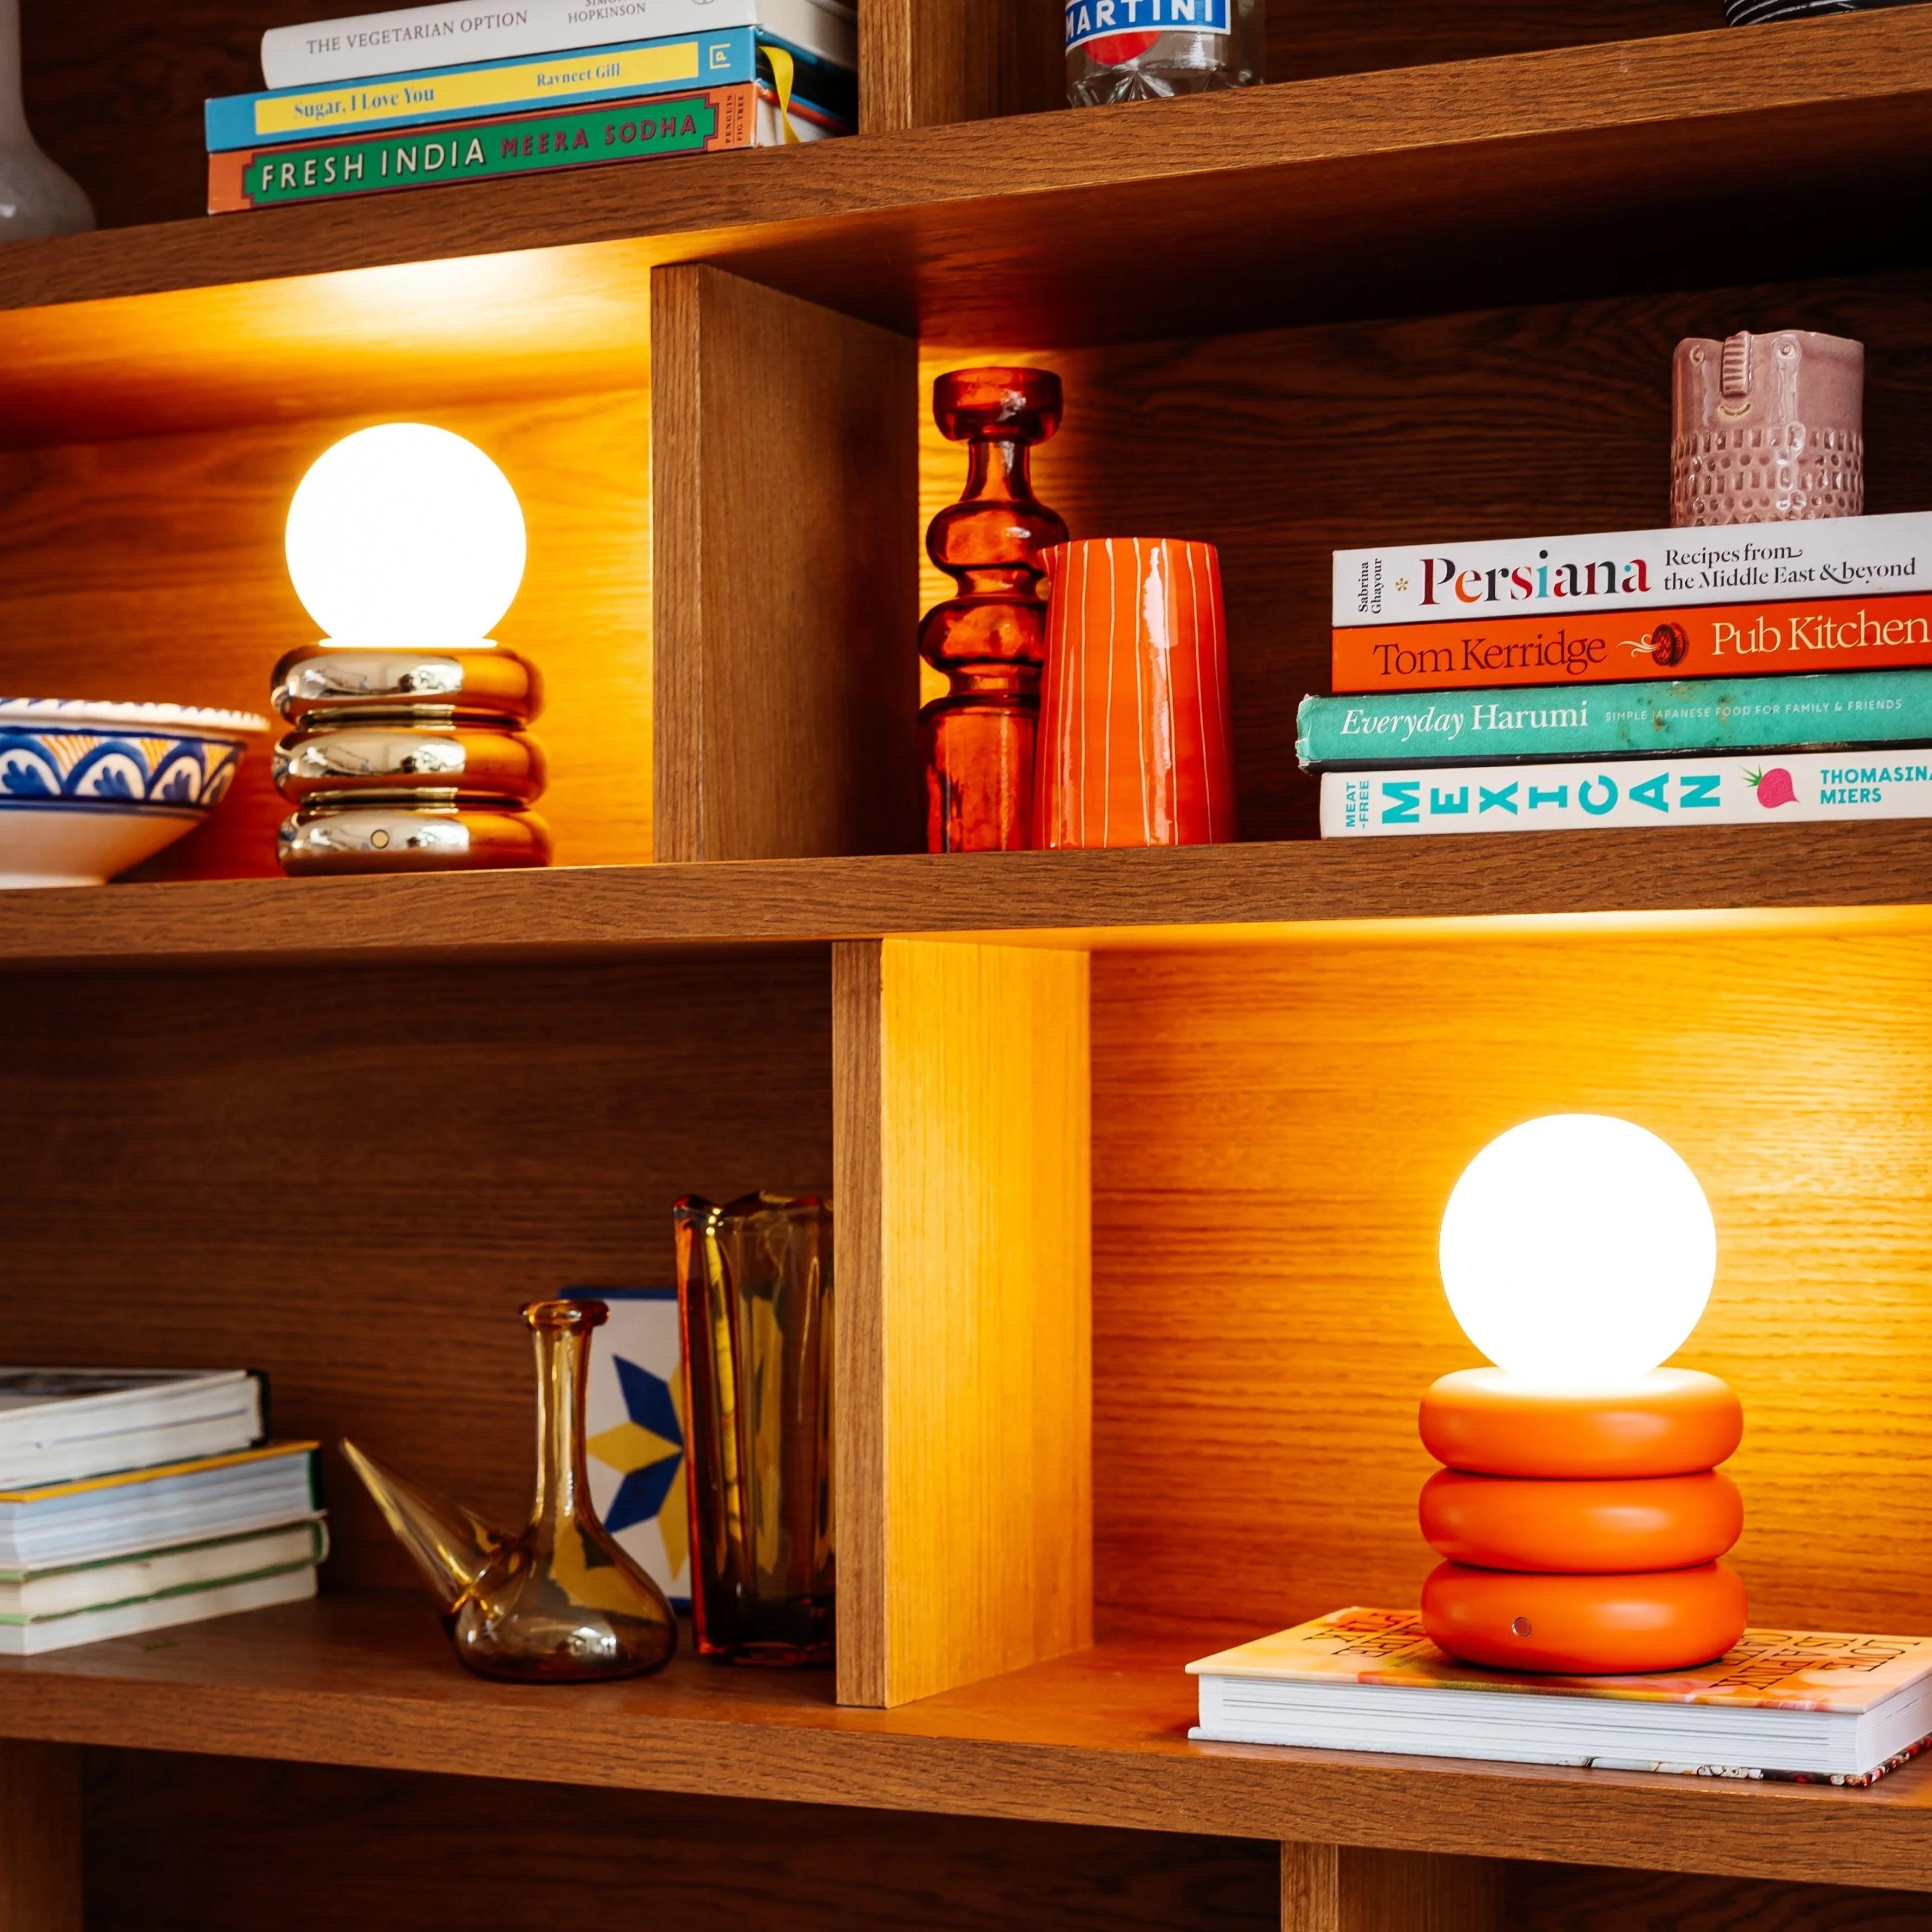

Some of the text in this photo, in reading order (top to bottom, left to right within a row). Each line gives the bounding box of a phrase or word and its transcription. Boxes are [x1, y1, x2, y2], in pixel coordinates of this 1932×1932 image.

[306, 10, 529, 54] THE VEGETARIAN OPTION
[568, 3, 646, 23] HOPKINSON
[1066, 0, 1213, 41] MARTINI
[537, 62, 620, 87] Ravneet Gill
[294, 87, 435, 121] Sugar, I Love You
[725, 95, 733, 144] PENGUIN
[501, 114, 696, 159] MEERA SODHA
[261, 137, 485, 193] FRESH INDIA
[1418, 550, 1652, 606] Persiana
[1664, 557, 1917, 591] the Middle East & beyond
[1665, 543, 1804, 569] Recipes from
[1358, 561, 1369, 612] Sabrina
[1370, 558, 1383, 614] Ghayour
[1373, 629, 1607, 676] Tom Kerridge
[1711, 609, 1931, 657] Pub Kitchen
[1340, 700, 1588, 742] Everyday Harumi
[1605, 698, 1903, 722] SIMPLE JAPANESE FOOD FOR FAMILY & FRIENDS
[1346, 782, 1356, 828] MEAT
[1359, 780, 1369, 829] -FREE
[1381, 772, 1721, 824] MEXICAN
[1820, 787, 1882, 805] MIERS
[1817, 1639, 1922, 1672] LOVE
